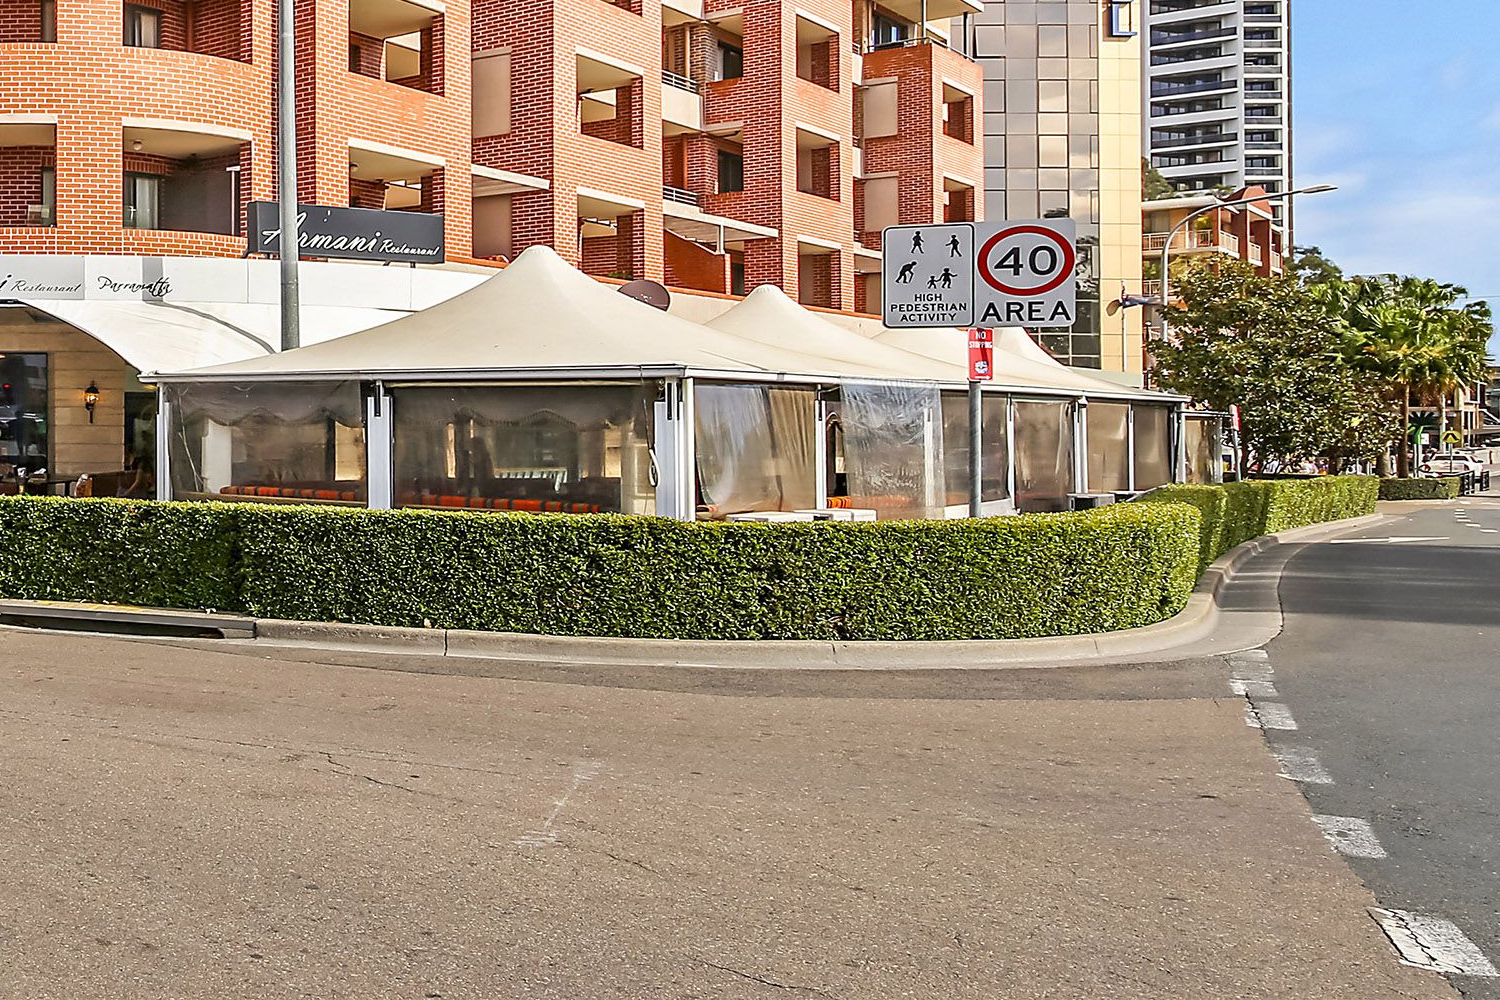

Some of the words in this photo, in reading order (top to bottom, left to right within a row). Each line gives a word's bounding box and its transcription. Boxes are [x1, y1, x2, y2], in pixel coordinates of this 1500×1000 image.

[262, 211, 382, 252] Armani
[379, 239, 440, 256] Restaurant
[993, 245, 1058, 277] 40
[10, 280, 82, 292] Restaurant
[914, 293, 943, 302] HIGH
[890, 302, 967, 313] PEDESTRIAN
[980, 300, 1072, 323] AREA
[900, 312, 957, 322] ACTIVITY
[975, 331, 987, 340] NO
